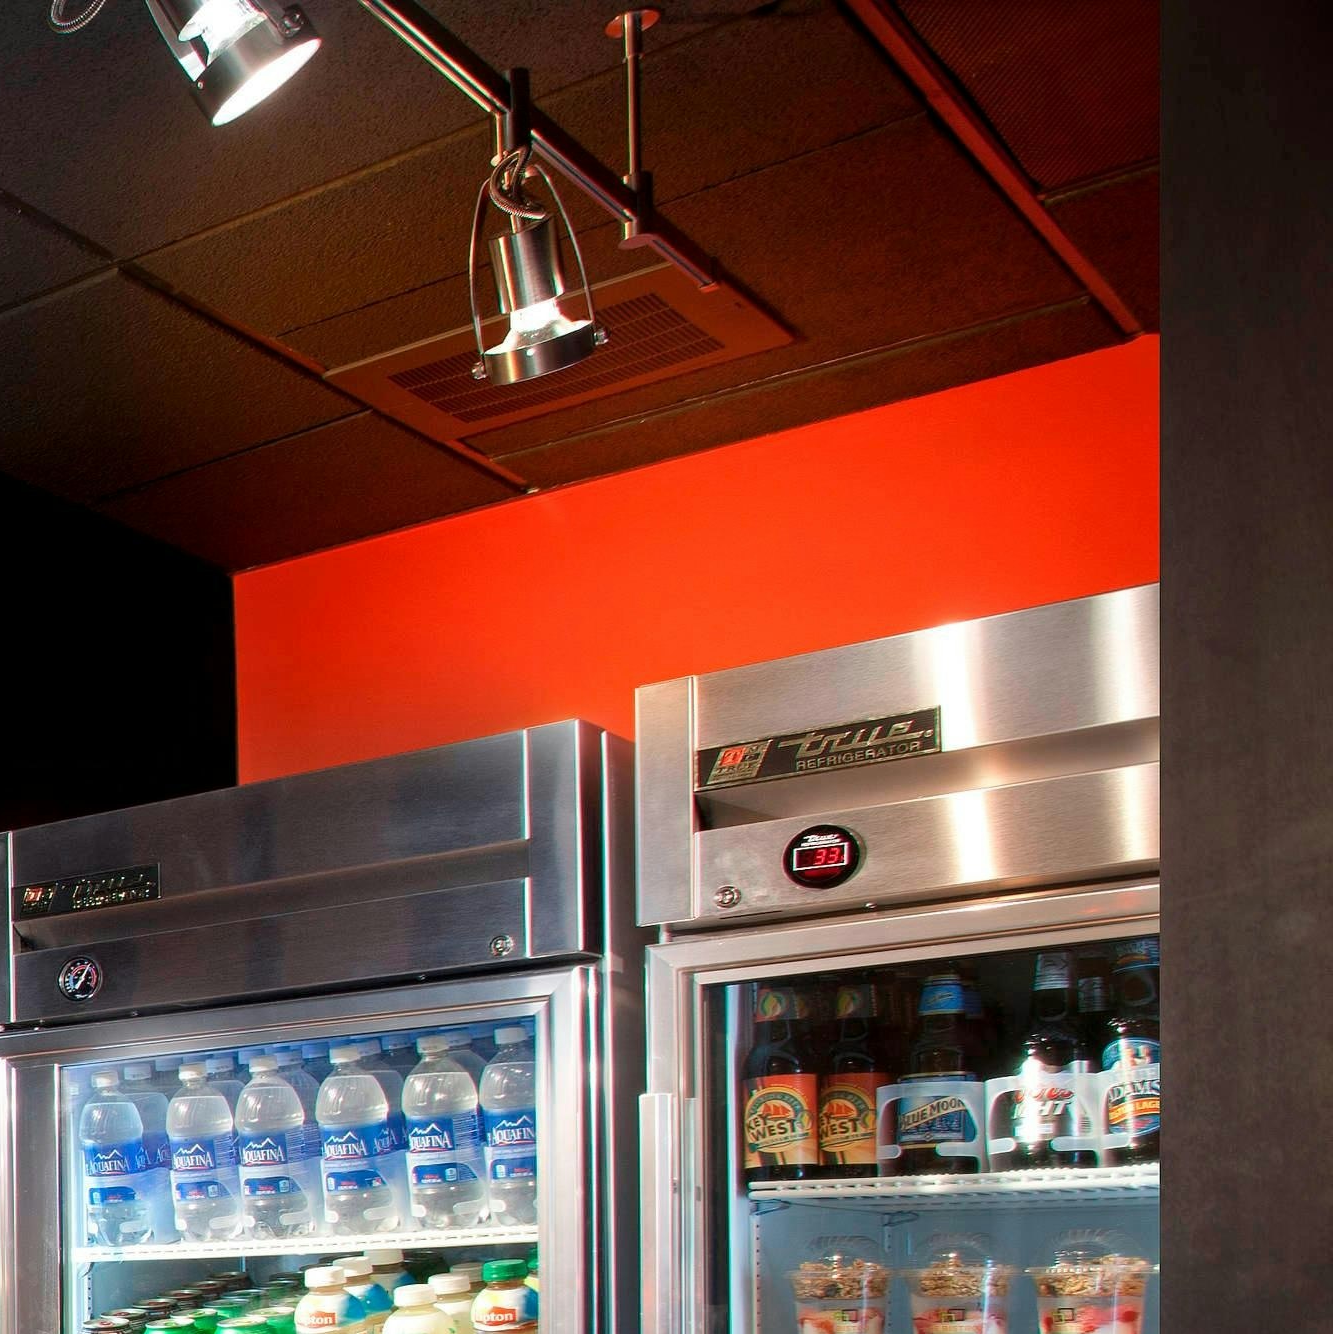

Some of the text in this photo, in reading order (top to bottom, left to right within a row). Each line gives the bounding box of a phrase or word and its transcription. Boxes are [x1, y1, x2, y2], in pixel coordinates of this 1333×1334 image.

[796, 741, 921, 771] REFRIGERATOR
[746, 1113, 771, 1131] KEY
[751, 1119, 796, 1141] WEST
[89, 1158, 130, 1174] AQUAFINA
